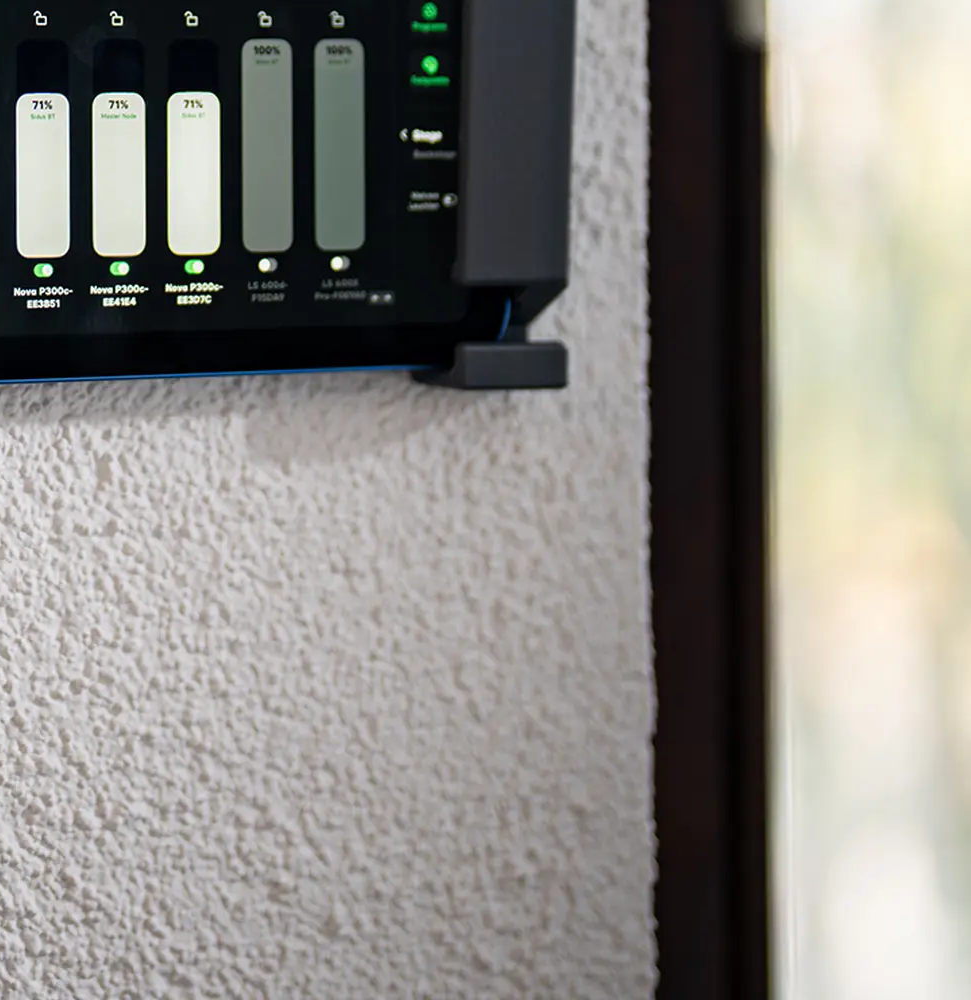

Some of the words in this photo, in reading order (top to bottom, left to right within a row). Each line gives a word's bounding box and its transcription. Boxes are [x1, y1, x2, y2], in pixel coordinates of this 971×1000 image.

[253, 45, 281, 56] 100%
[326, 45, 353, 56] 100%
[32, 99, 53, 110] 71%
[108, 99, 129, 110] 71%
[183, 98, 204, 109] 71%
[13, 287, 37, 297] Nova
[38, 286, 74, 297] P300c-
[90, 285, 113, 295] Nova
[115, 284, 149, 295] P300c-
[165, 283, 188, 293] Nova
[189, 282, 224, 293] P300c-
